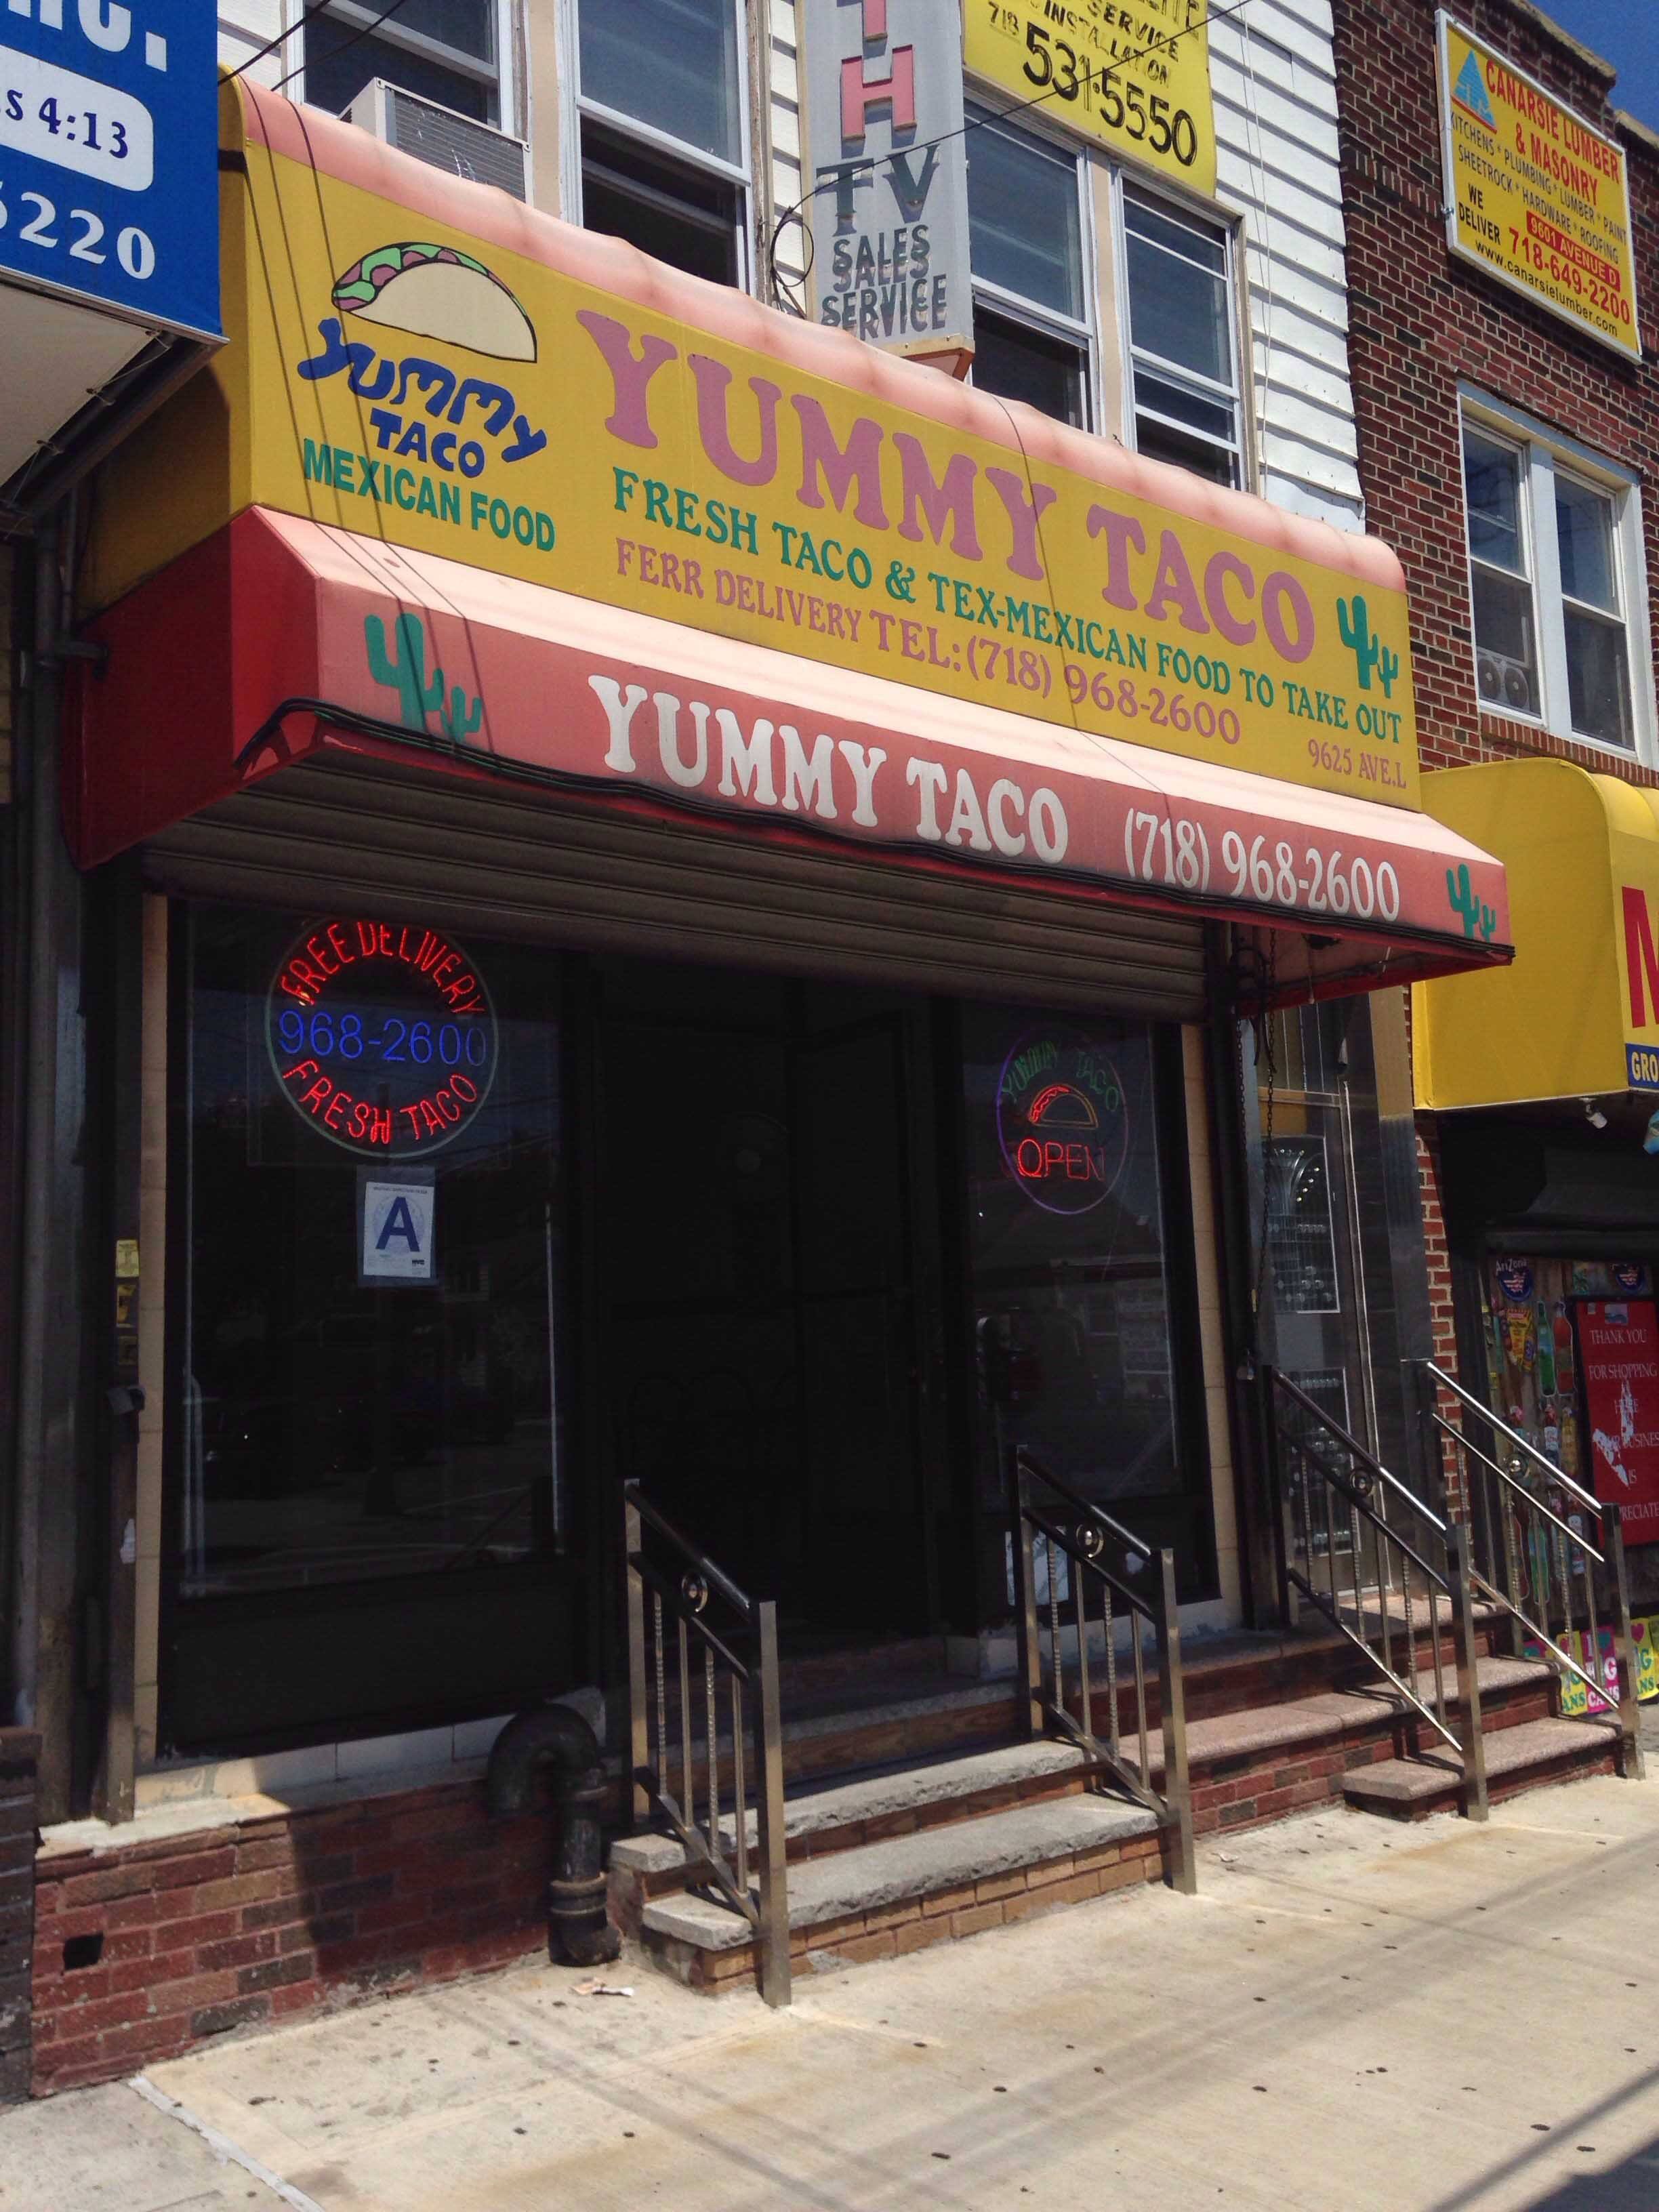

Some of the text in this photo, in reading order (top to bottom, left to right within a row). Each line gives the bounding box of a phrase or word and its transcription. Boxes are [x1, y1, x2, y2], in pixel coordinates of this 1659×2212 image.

[988, 1, 1019, 36] 718
[1087, 0, 1179, 62] SERVICE
[39, 98, 128, 159] 4:13
[1486, 60, 1620, 184] CANARSIE LUMBER
[816, 143, 941, 218] TV
[1450, 111, 1628, 246] KITCHENS PLUMBING LUMBER PAINT
[1468, 183, 1484, 210] WE
[1515, 122, 1598, 206] & MASONRY
[0, 180, 155, 280] 220
[1458, 144, 1619, 264] SHEETROCK HARDWARE ROOFING
[1458, 201, 1502, 246] DELIVER
[832, 224, 930, 272] SALES
[1509, 227, 1631, 325] 718-649-2200
[1531, 216, 1617, 287] 9601 AVENUE D
[821, 274, 947, 325] SERVICE
[1475, 241, 1618, 337] www.canarsielumber.com
[369, 407, 485, 478] TACO
[303, 437, 556, 552] MEXICAN FOOD
[575, 309, 1315, 663] YUMMY TACO
[613, 466, 1402, 743] FRESH TACO & TEX-MEXICAN FOOD TO TAKE OUT
[615, 537, 704, 599] FERR
[714, 569, 862, 642] DELIVERY
[1063, 663, 1240, 745] 968-2600
[1308, 738, 1353, 775] 9625
[588, 674, 1399, 922] YUMMY TACO (718) 968-2600
[281, 921, 485, 1014] FREE DELIVERY
[279, 1009, 487, 1067] 968-2600
[1631, 1051, 1659, 1083] GRO
[282, 1059, 478, 1145] FRESH TACO
[1017, 1138, 1106, 1181] OPEN
[375, 1196, 420, 1252] A
[1588, 1361, 1658, 1380] FOR SHOPPING
[1589, 1328, 1647, 1345] THANK YOU
